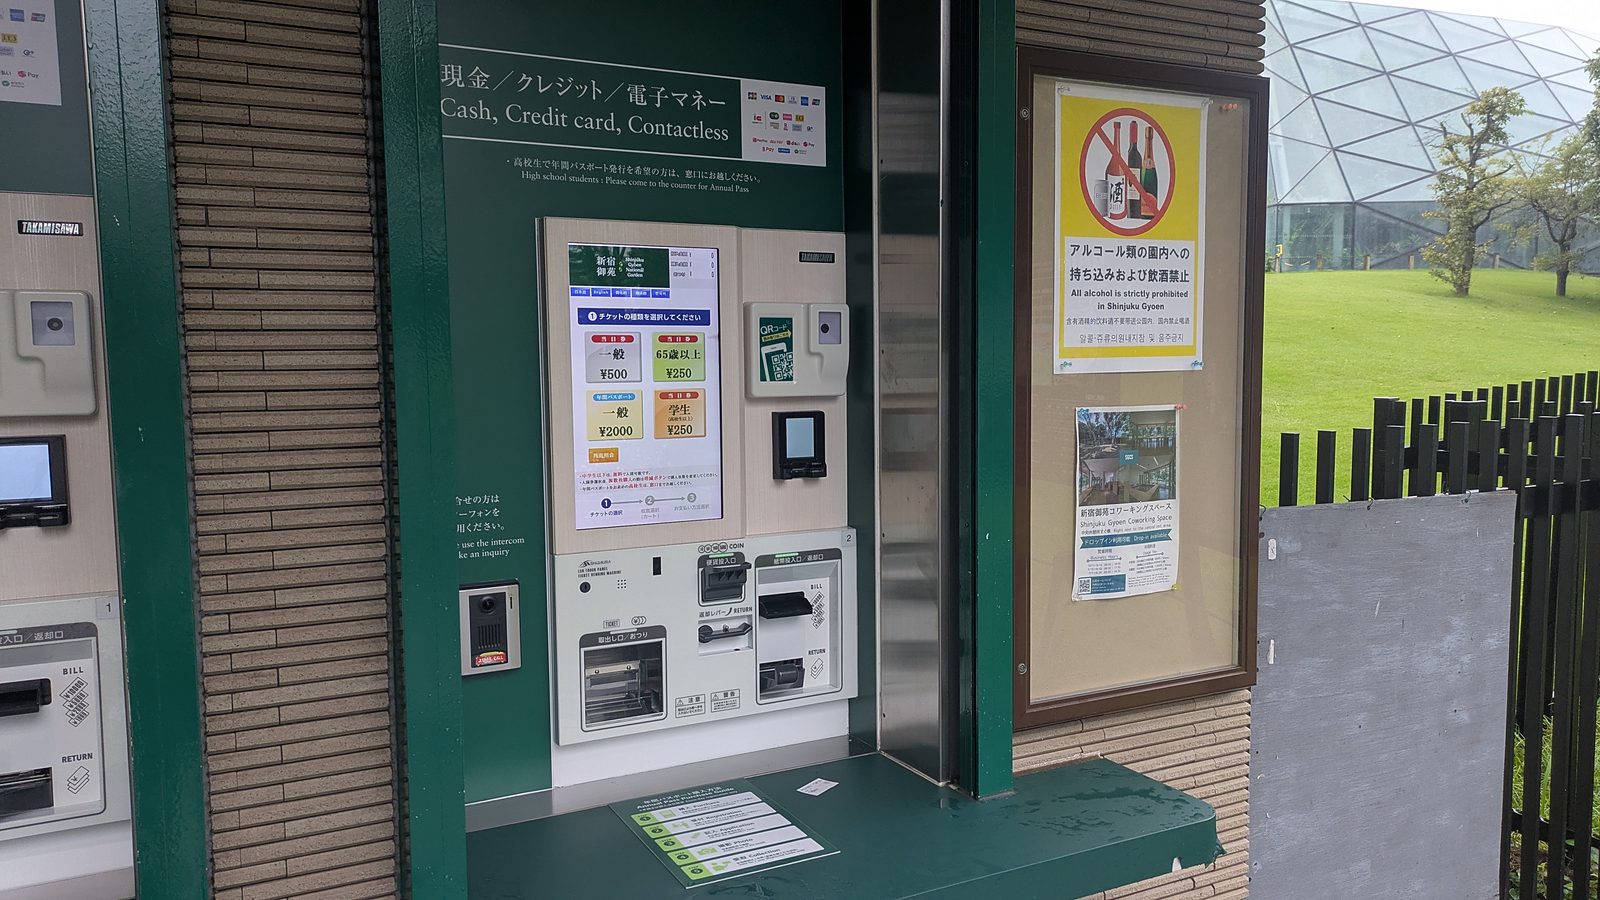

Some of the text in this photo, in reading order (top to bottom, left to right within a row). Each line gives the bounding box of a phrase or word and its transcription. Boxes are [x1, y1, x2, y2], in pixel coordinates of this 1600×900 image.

[440, 98, 498, 124] Cash,
[505, 104, 568, 127] Credit
[574, 112, 621, 135] card,
[628, 116, 729, 141] Contactless
[521, 170, 540, 181] High
[542, 172, 567, 181] school
[569, 174, 599, 183] students
[605, 176, 627, 185] Please
[629, 179, 647, 187] come
[649, 178, 656, 187] to
[659, 178, 670, 188] the
[670, 180, 697, 190] counter
[698, 180, 708, 190] for
[710, 181, 734, 191] Annual
[735, 183, 749, 193] Pass
[1109, 178, 1126, 204] 酒
[22, 221, 79, 235] TAKAMISAWA
[1070, 244, 1190, 259] アルコール類の園内への
[596, 255, 616, 266] 新宿
[596, 266, 616, 277] 御苑
[1069, 267, 1190, 283] 持ち込みおよび飲酒禁止
[1071, 289, 1189, 299] All alcohol is strictly prohibited
[1097, 302, 1165, 311] in Shinjuku Gyoen
[599, 311, 702, 321] チケットの種類を選択してください
[761, 324, 788, 335] QRコード
[599, 348, 625, 360] 一般
[656, 350, 701, 360] 65歳以上
[600, 369, 628, 379] ¥500
[666, 368, 692, 379] ¥250
[603, 406, 629, 418] 一般
[669, 404, 691, 416] 学生
[598, 426, 633, 437] ¥2000
[667, 425, 693, 435] ¥250
[1080, 503, 1172, 518] 新宿御苑コワーキングスペース
[1080, 514, 1173, 530] Shinjuku Gyoen Coworking Space
[476, 539, 489, 547] the
[491, 537, 525, 546] intercom
[846, 535, 852, 543] 2
[729, 542, 744, 550] COIN
[482, 548, 510, 558] inquiry
[106, 603, 112, 613] 1
[605, 620, 619, 628] TICKET
[808, 648, 826, 656] RETURN
[62, 667, 84, 676] BILL
[62, 752, 93, 763] RETURN
